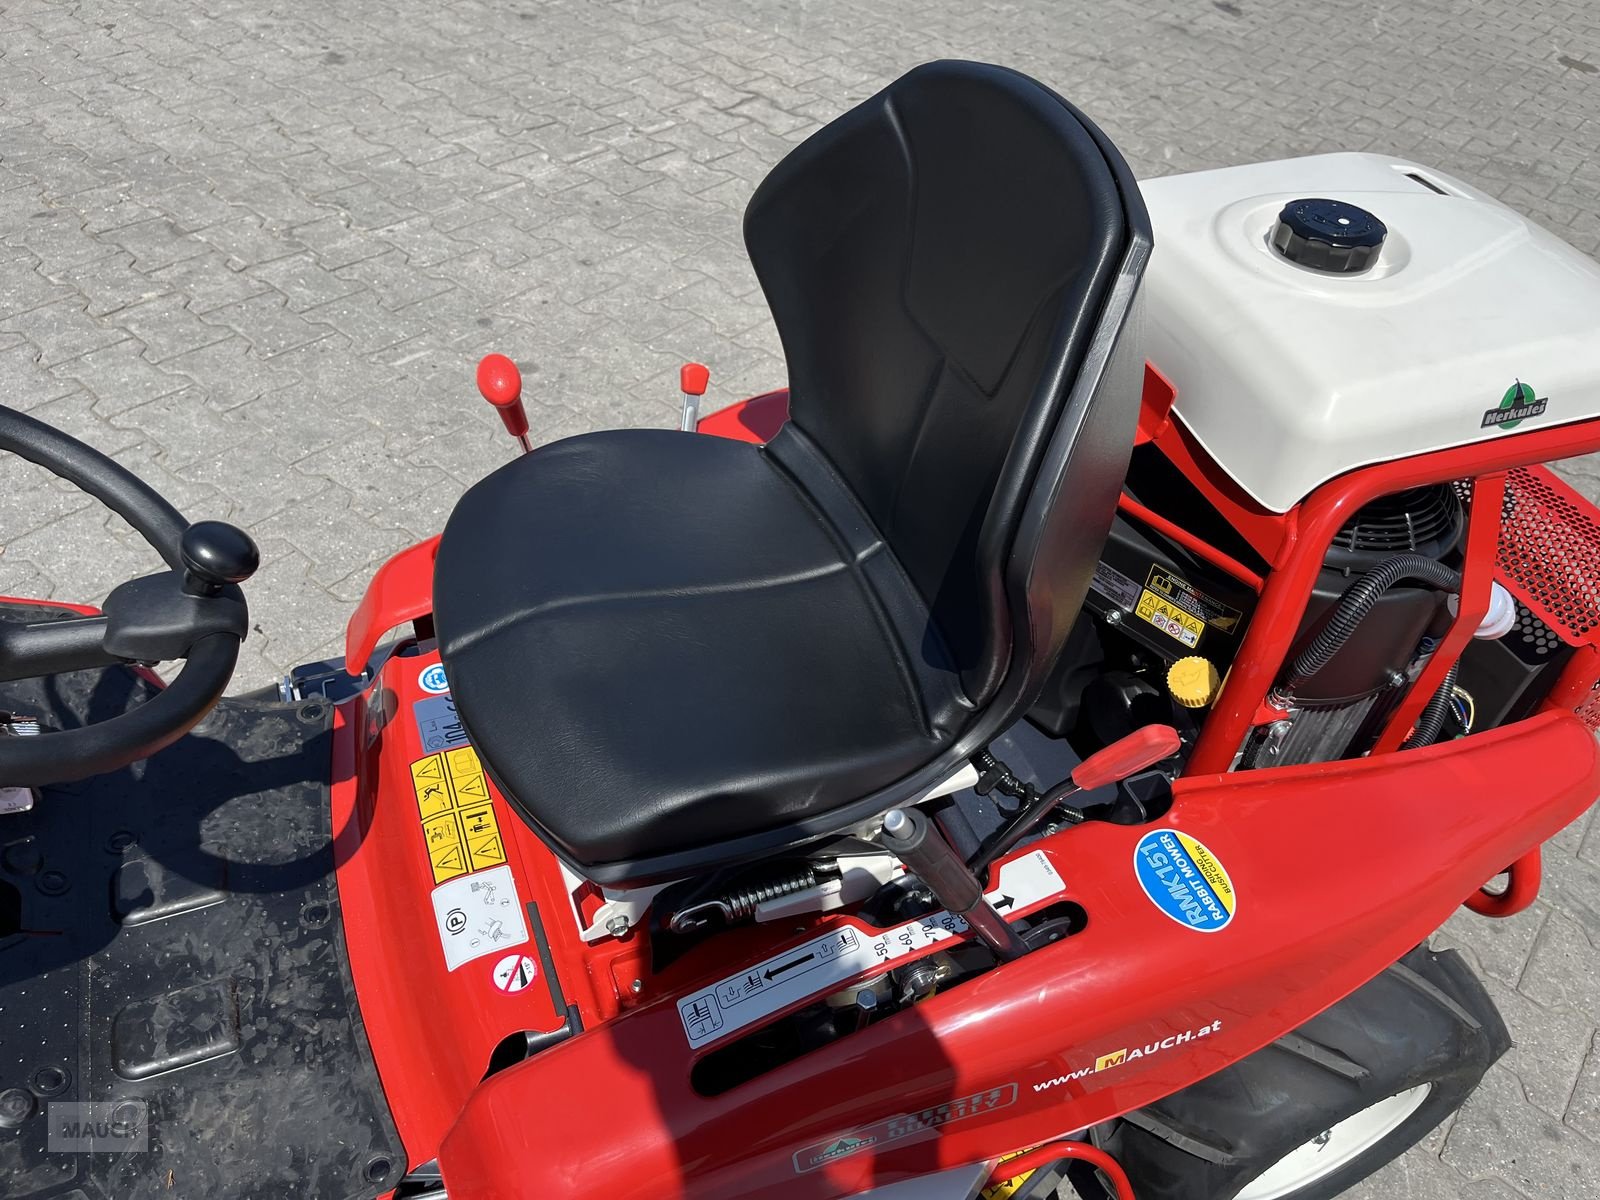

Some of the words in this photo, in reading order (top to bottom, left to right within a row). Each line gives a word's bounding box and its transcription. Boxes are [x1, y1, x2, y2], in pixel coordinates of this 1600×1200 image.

[1484, 401, 1546, 425] Herkules
[1160, 833, 1195, 878] MOWER
[1194, 844, 1217, 873] CUTTER
[1196, 859, 1216, 884] RIDING
[1213, 873, 1232, 894] BUSH
[1140, 842, 1209, 926] RMK151
[1189, 880, 1225, 921] RABBIT
[922, 924, 936, 938] 70
[941, 917, 956, 930] 80
[874, 942, 888, 957] 50
[898, 933, 913, 946] 60
[1032, 1019, 1222, 1093] www.MAUCH.at
